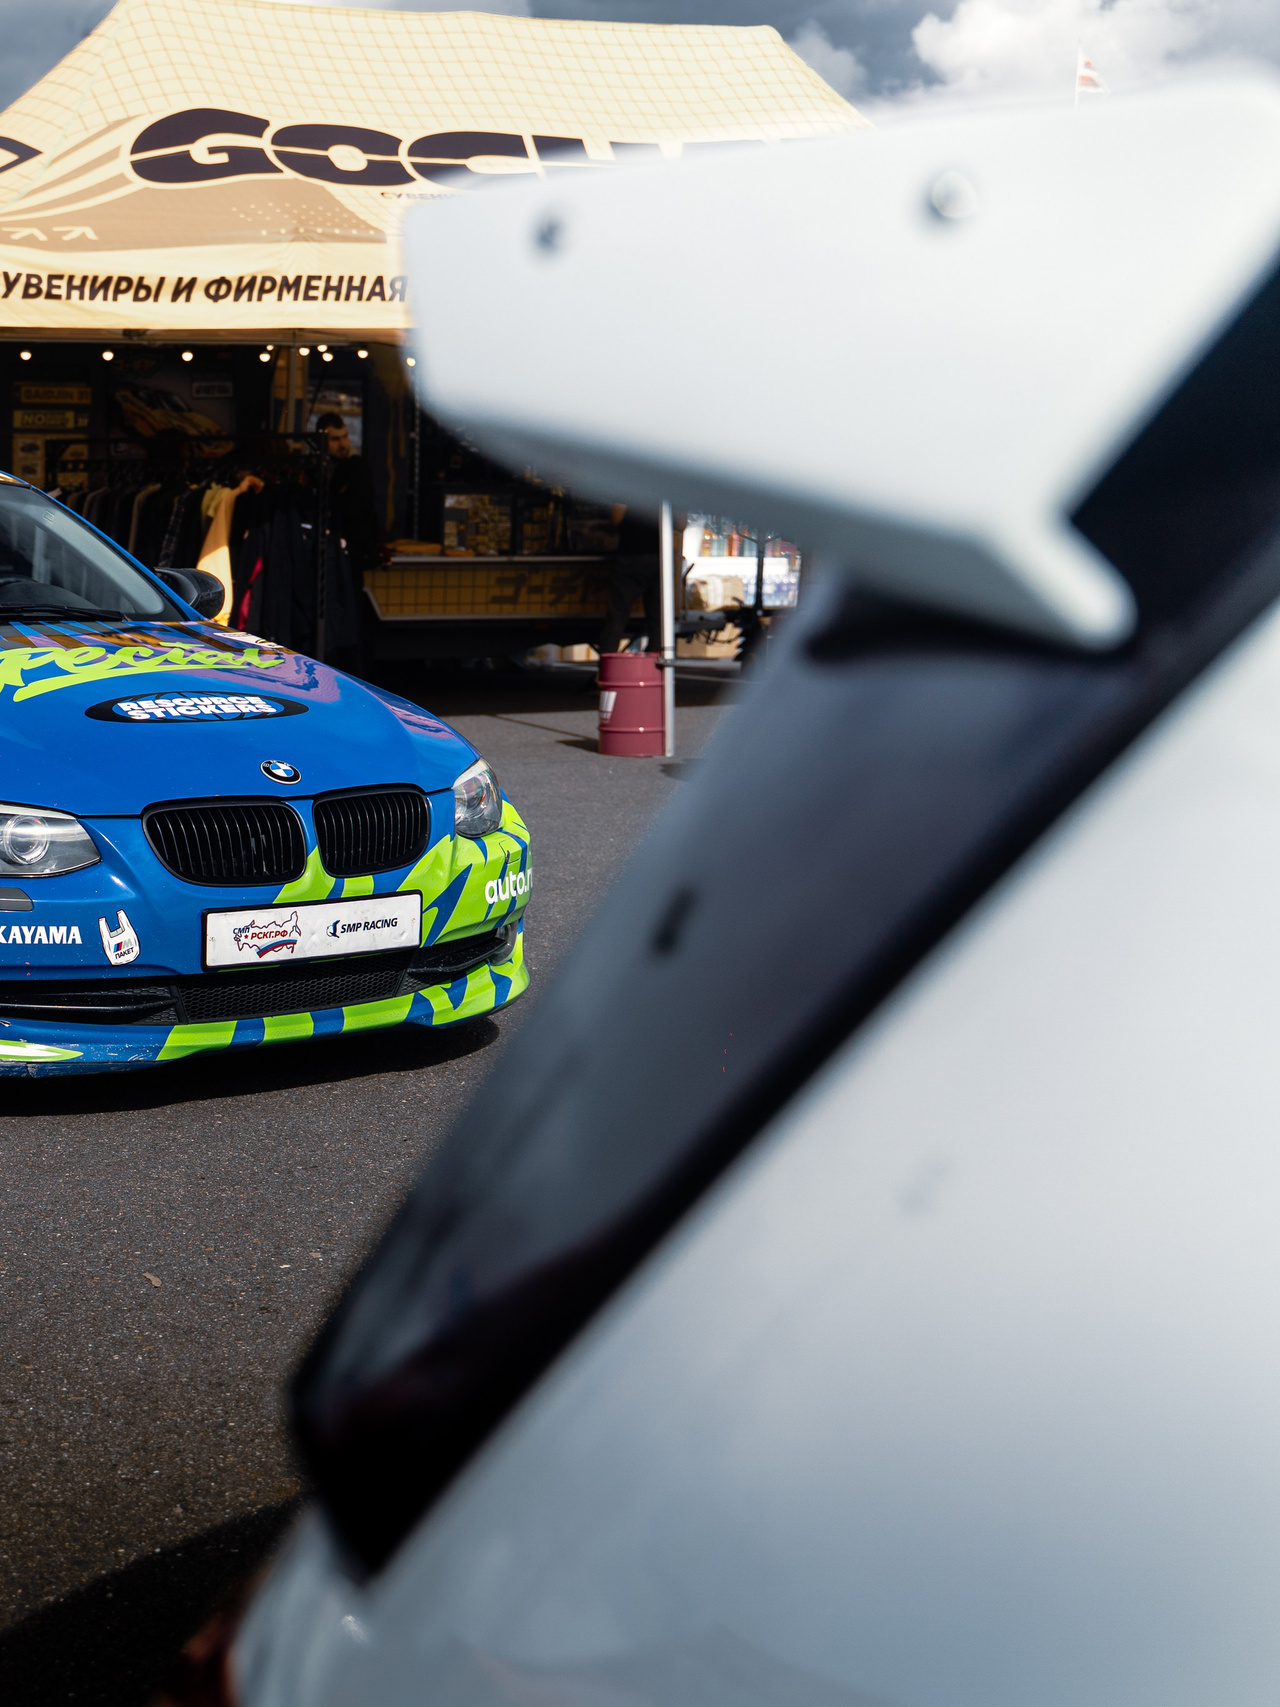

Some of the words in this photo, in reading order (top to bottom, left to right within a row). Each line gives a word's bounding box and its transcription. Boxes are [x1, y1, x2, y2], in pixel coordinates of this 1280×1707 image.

[170, 276, 198, 303] И
[203, 274, 409, 303] ФИРМЕННАЯ
[116, 696, 270, 712] RESOURCE
[126, 703, 278, 721] STICKERS
[232, 926, 250, 935] СМП
[340, 922, 362, 934] SMP
[363, 917, 398, 931] RACING
[250, 929, 289, 941] РСКГ.РФ
[114, 946, 135, 960] ПАКЕТ
